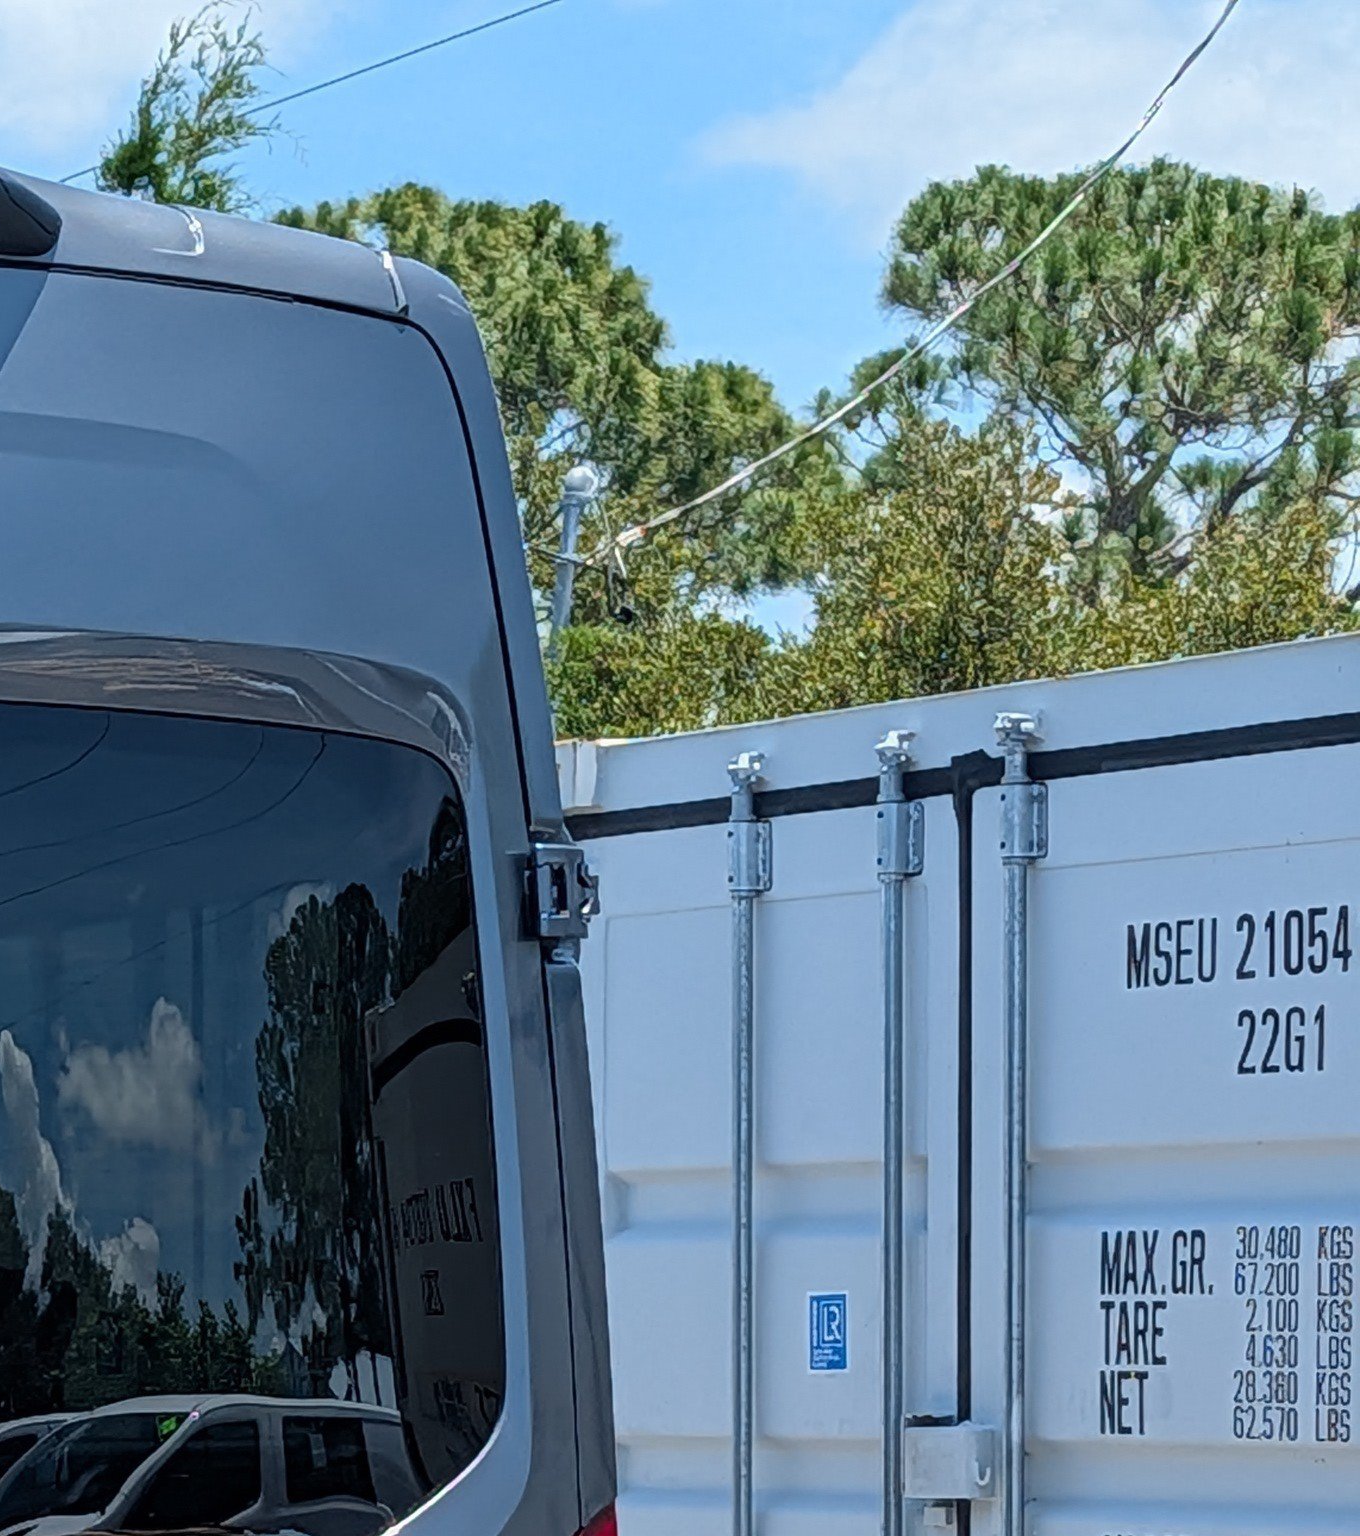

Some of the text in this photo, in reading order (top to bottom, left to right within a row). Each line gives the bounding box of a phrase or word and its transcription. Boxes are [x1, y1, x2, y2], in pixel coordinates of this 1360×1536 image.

[1126, 904, 1353, 990] MSEU 21054
[1236, 1003, 1326, 1076] 22G1
[1316, 1225, 1354, 1261] KGS
[1316, 1262, 1354, 1298] LBS
[1099, 1301, 1168, 1366] TARE
[1316, 1298, 1354, 1333] KGS
[1315, 1334, 1353, 1371] LBS
[1099, 1369, 1150, 1436] NET
[1315, 1371, 1352, 1407] KGS
[1314, 1407, 1352, 1444] LBS
